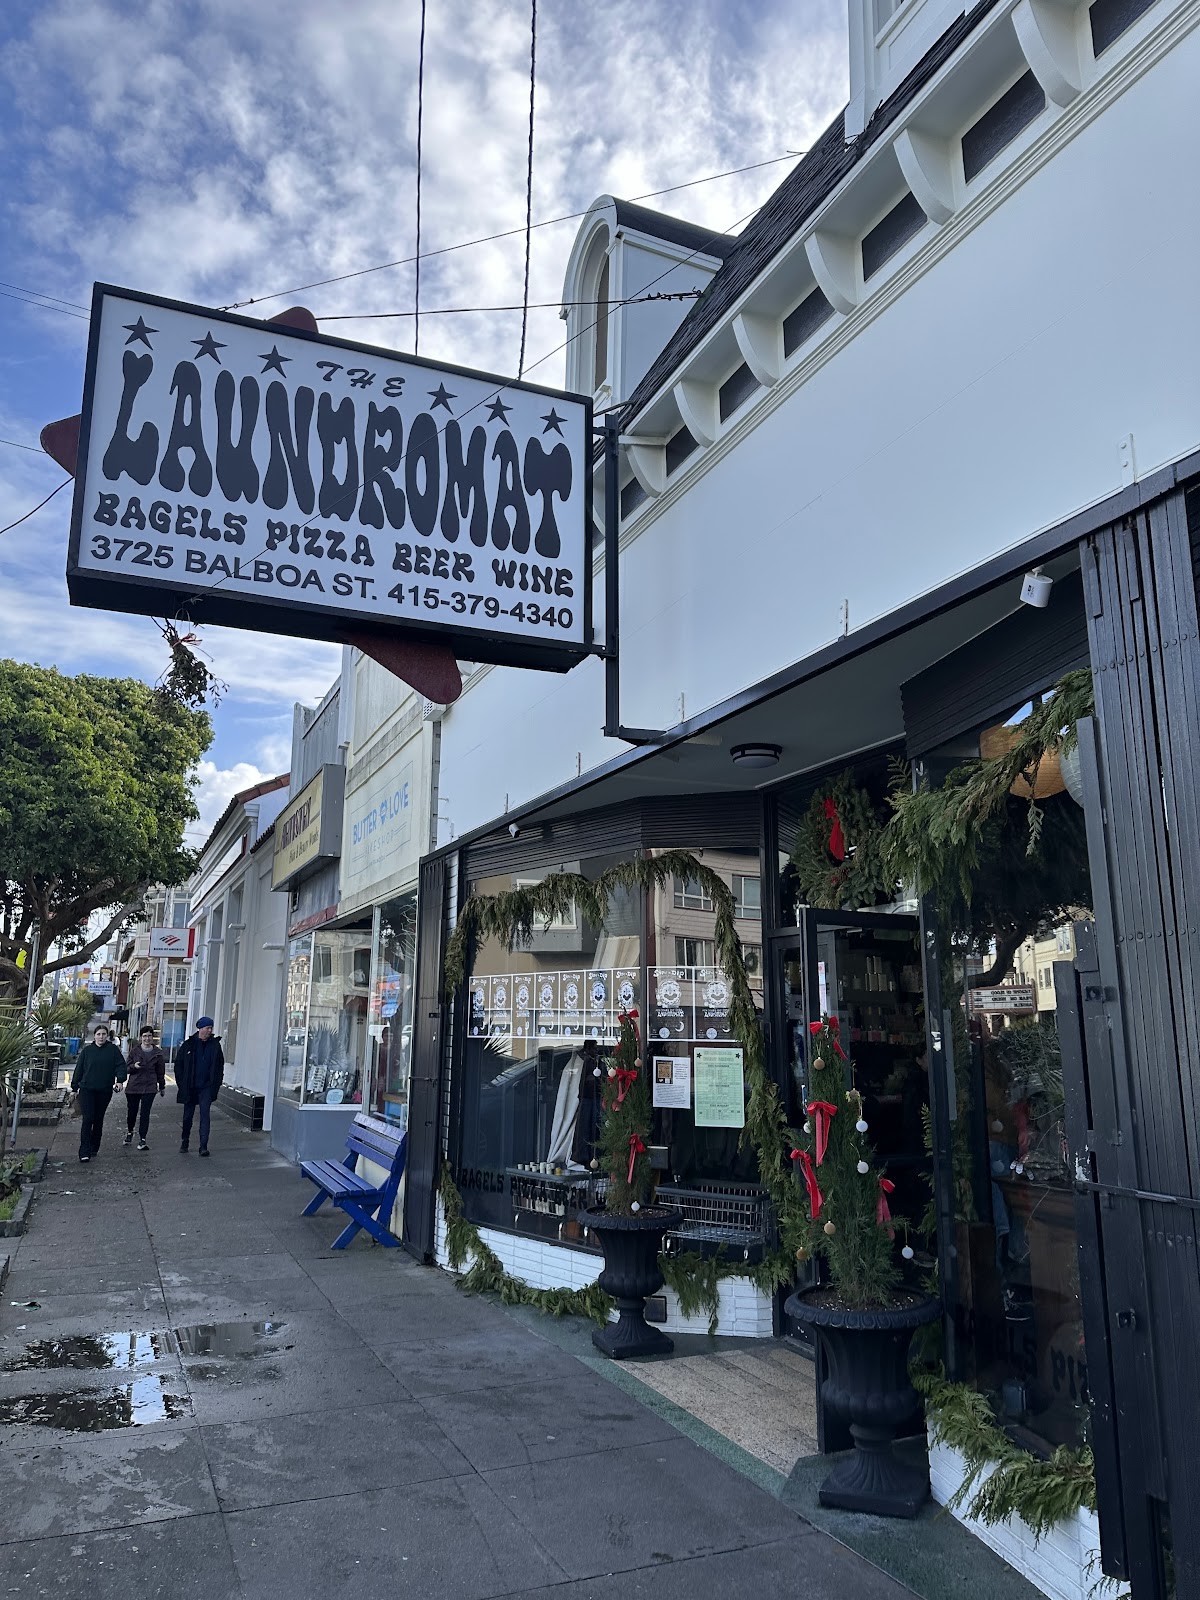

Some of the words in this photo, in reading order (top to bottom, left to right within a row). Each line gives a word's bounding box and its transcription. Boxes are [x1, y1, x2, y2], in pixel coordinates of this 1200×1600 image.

[316, 360, 406, 398] THE
[102, 349, 573, 559] LAUNDROMAT
[90, 534, 174, 569] 3725
[184, 549, 326, 593] BALBOA
[332, 572, 378, 600] ST.
[387, 583, 574, 629] 415-379-4340
[93, 491, 248, 546] BAGELS
[265, 518, 375, 567] PIZZA
[392, 541, 475, 583] BEER
[491, 558, 574, 598] WINE
[353, 808, 377, 845] BUTTER
[389, 782, 409, 820] LOVE
[460, 1168, 505, 1195] BAGELS
